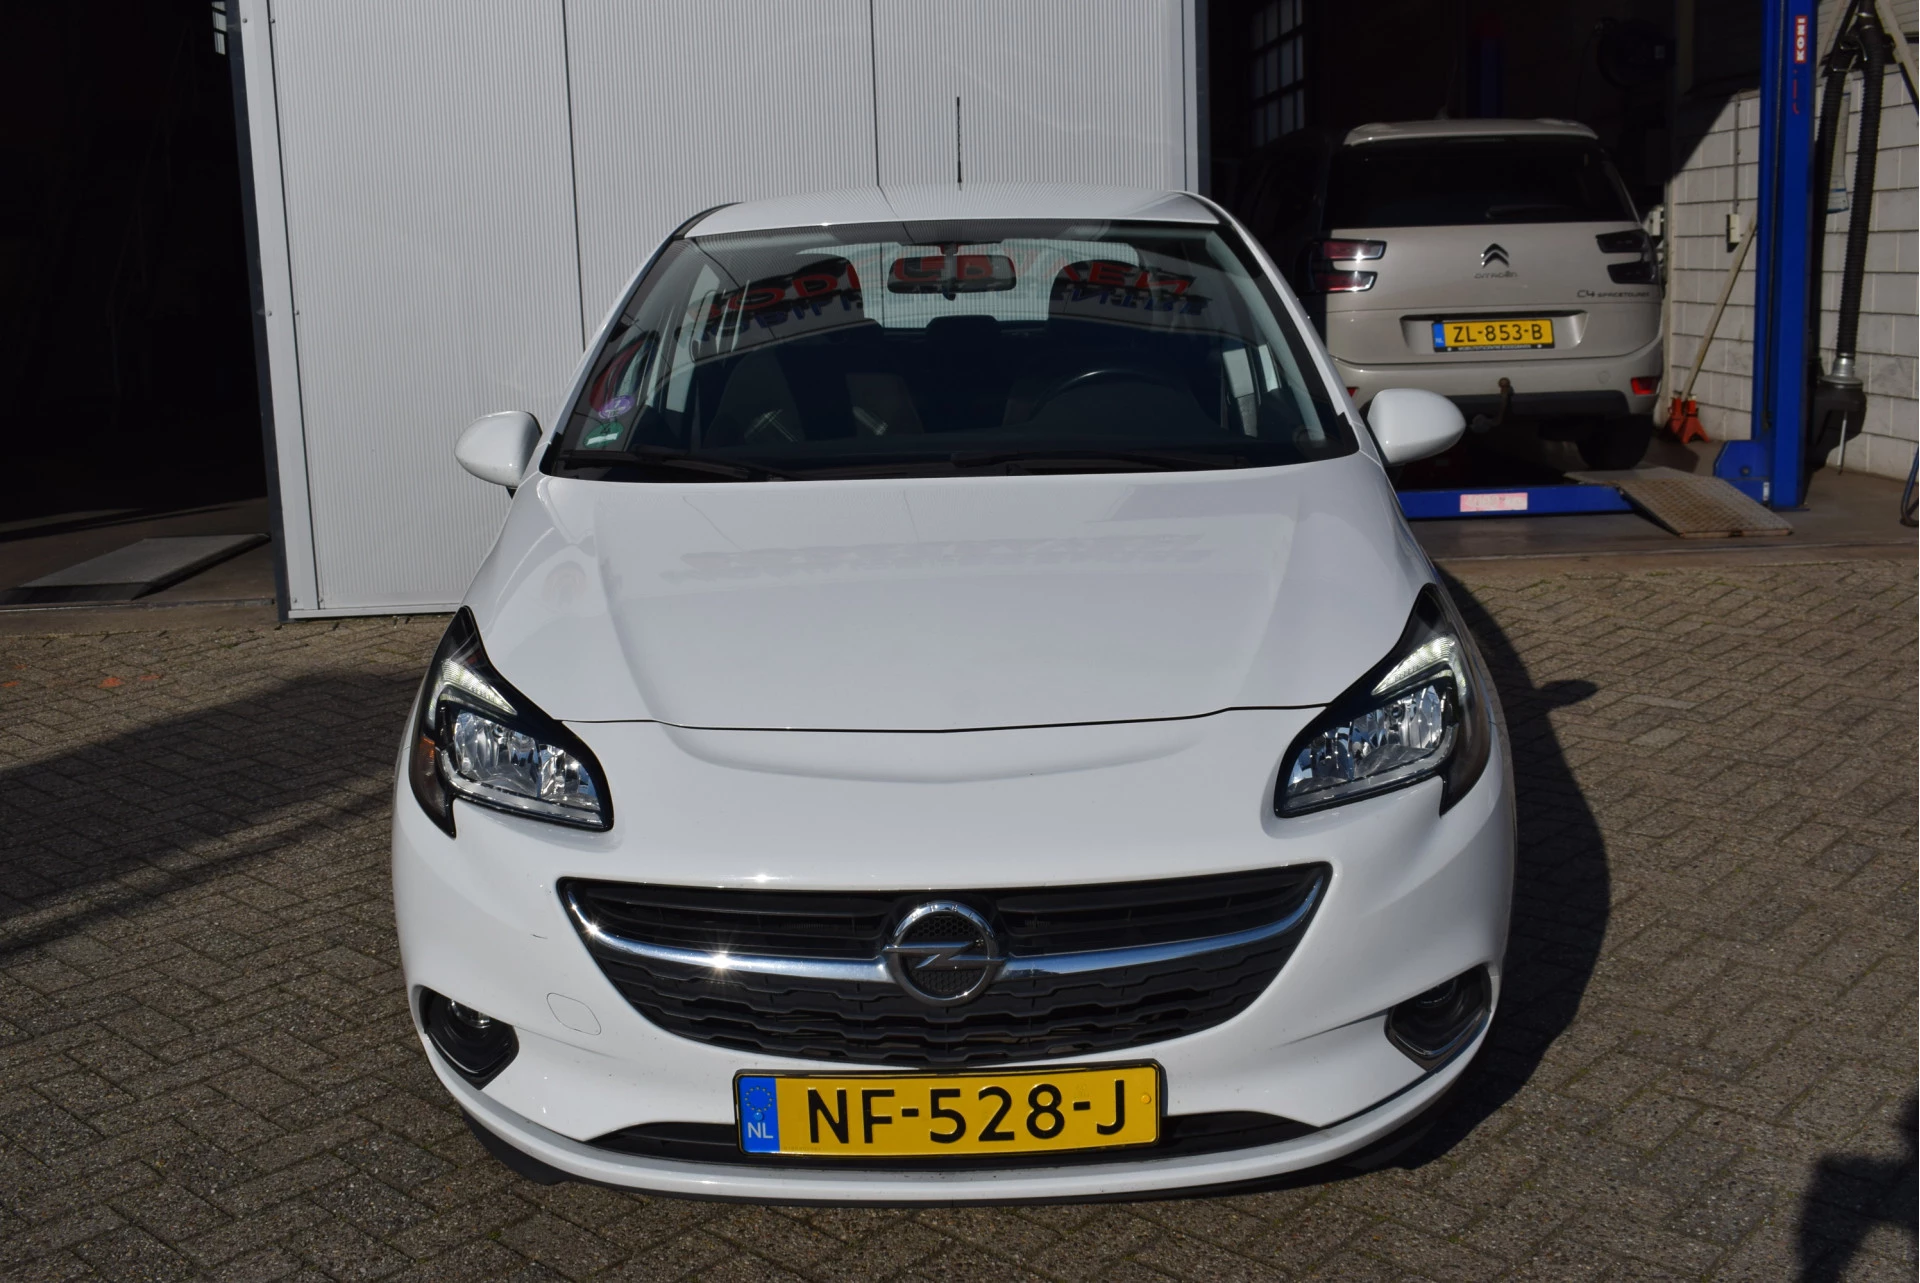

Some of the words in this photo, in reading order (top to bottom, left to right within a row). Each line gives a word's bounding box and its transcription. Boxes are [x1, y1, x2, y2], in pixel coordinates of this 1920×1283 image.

[1796, 17, 1805, 61] KONI
[1577, 289, 1596, 298] C4
[1453, 323, 1543, 343] ZL-853-B
[807, 1079, 1126, 1144] NF-528-J
[747, 1122, 774, 1139] NL
